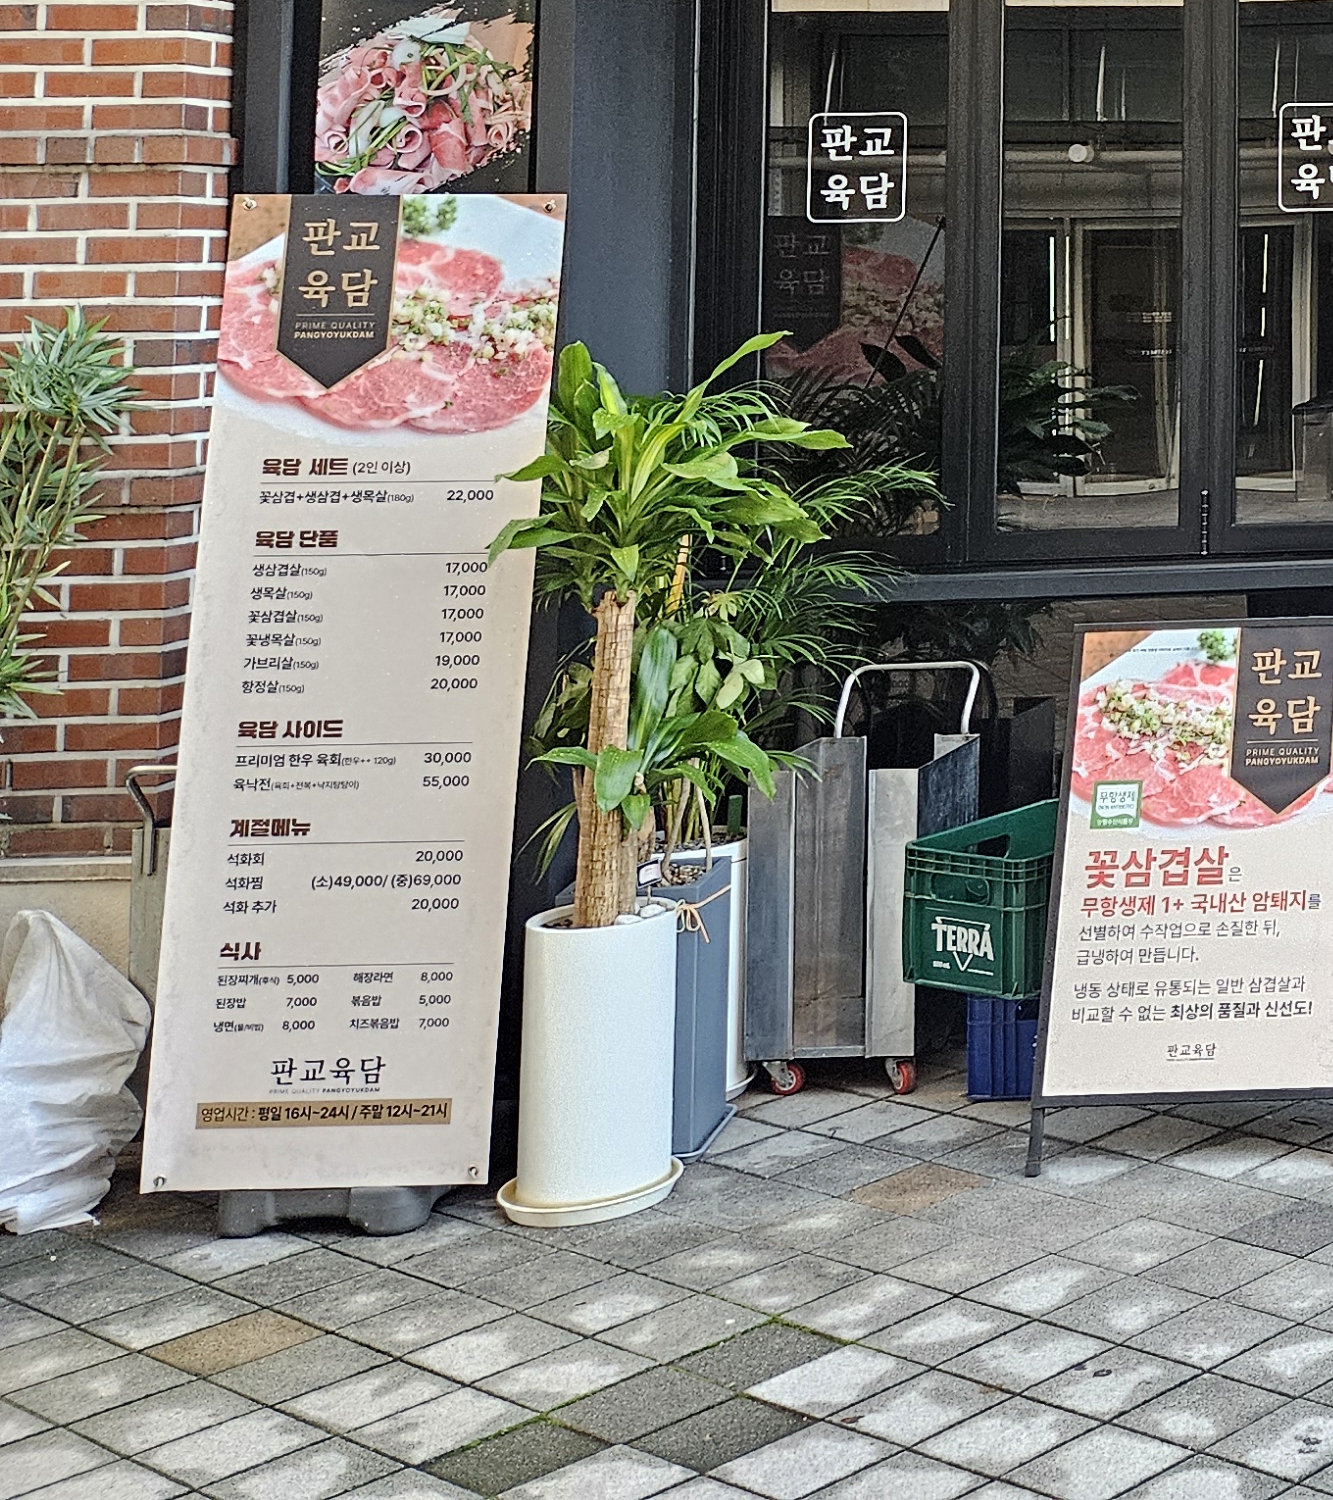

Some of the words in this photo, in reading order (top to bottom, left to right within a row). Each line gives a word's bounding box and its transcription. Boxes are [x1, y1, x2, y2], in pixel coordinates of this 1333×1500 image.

[820, 125, 895, 161] 판교
[820, 172, 894, 211] 육담
[302, 218, 380, 256] 판교
[298, 269, 379, 308] 육담
[262, 458, 302, 477] 육담
[309, 457, 348, 476] 세트
[352, 460, 379, 476] (2인
[381, 459, 411, 475] 이상)
[446, 489, 494, 503] 22,000
[256, 530, 294, 548] 육담
[299, 530, 338, 547] 단품
[445, 562, 488, 575] 17,000
[443, 585, 486, 598] 17,000
[441, 608, 484, 621] 17,000
[439, 631, 482, 644] 17,000
[435, 655, 480, 668] 19,000
[1251, 648, 1323, 684] 판교
[430, 678, 478, 691] 20,000
[1249, 696, 1320, 735] 육담
[237, 721, 278, 739] 육담
[282, 720, 343, 739] 사이드
[235, 754, 285, 768] 프리미엄
[289, 754, 313, 768] 한우
[424, 752, 472, 765] 30,000
[1278, 747, 1319, 756] QUALITY
[1245, 756, 1319, 766] PANGYOYUKDAM
[422, 776, 470, 789] 55,000
[230, 818, 311, 838] 계절메뉴
[227, 852, 265, 867] 석화회
[416, 850, 463, 863] 20,000
[1085, 846, 1242, 889] 꽃삼겹살은
[225, 876, 263, 891] 석화찜
[391, 873, 461, 889] (중)69,000
[223, 901, 248, 914] 석화
[252, 900, 276, 914] 추가
[411, 898, 459, 911] 20,000
[1080, 895, 1155, 918] 무항생제
[1162, 896, 1184, 914] 1+
[1191, 892, 1247, 914] 국내산
[1079, 924, 1136, 941] 선별하여
[1140, 922, 1211, 939] 수작업으로
[1216, 920, 1258, 937] 손질한
[1263, 919, 1280, 937] 뒤,
[219, 941, 262, 960] 식사
[931, 923, 994, 961] TERRA
[1076, 949, 1133, 966] 급냉하여
[1138, 946, 1199, 963] 만듭니다.
[287, 973, 319, 986] 5,000
[353, 972, 393, 985] 해장라면
[421, 971, 453, 983] 8,000
[1074, 982, 1102, 998] 냉동
[1106, 981, 1149, 998] 상태로
[1154, 979, 1211, 997] 유통되는
[1216, 977, 1244, 994] 일반
[1248, 976, 1305, 994] 삼겹살과
[215, 996, 246, 1010] 된장밥
[286, 996, 317, 1009] 7,000
[352, 994, 382, 1007] 볶음밥
[419, 994, 451, 1006] 5,000
[1072, 1006, 1114, 1023] 비교할
[1118, 1007, 1133, 1022] 수
[1138, 1005, 1166, 1022] 없는
[1170, 1004, 1213, 1021] 최상의
[1218, 1002, 1260, 1019] 품질과
[1265, 1001, 1312, 1017] 신선도!
[282, 1019, 315, 1032] 8,000
[419, 1017, 449, 1029] 7,000
[1167, 1043, 1216, 1058] 판교육담
[270, 1055, 386, 1085] 판교육담
[201, 1106, 249, 1123] 영업시간
[258, 1106, 282, 1121] 평일
[285, 1105, 349, 1121] 16시~24시
[386, 1103, 447, 1119] 12시~21시
